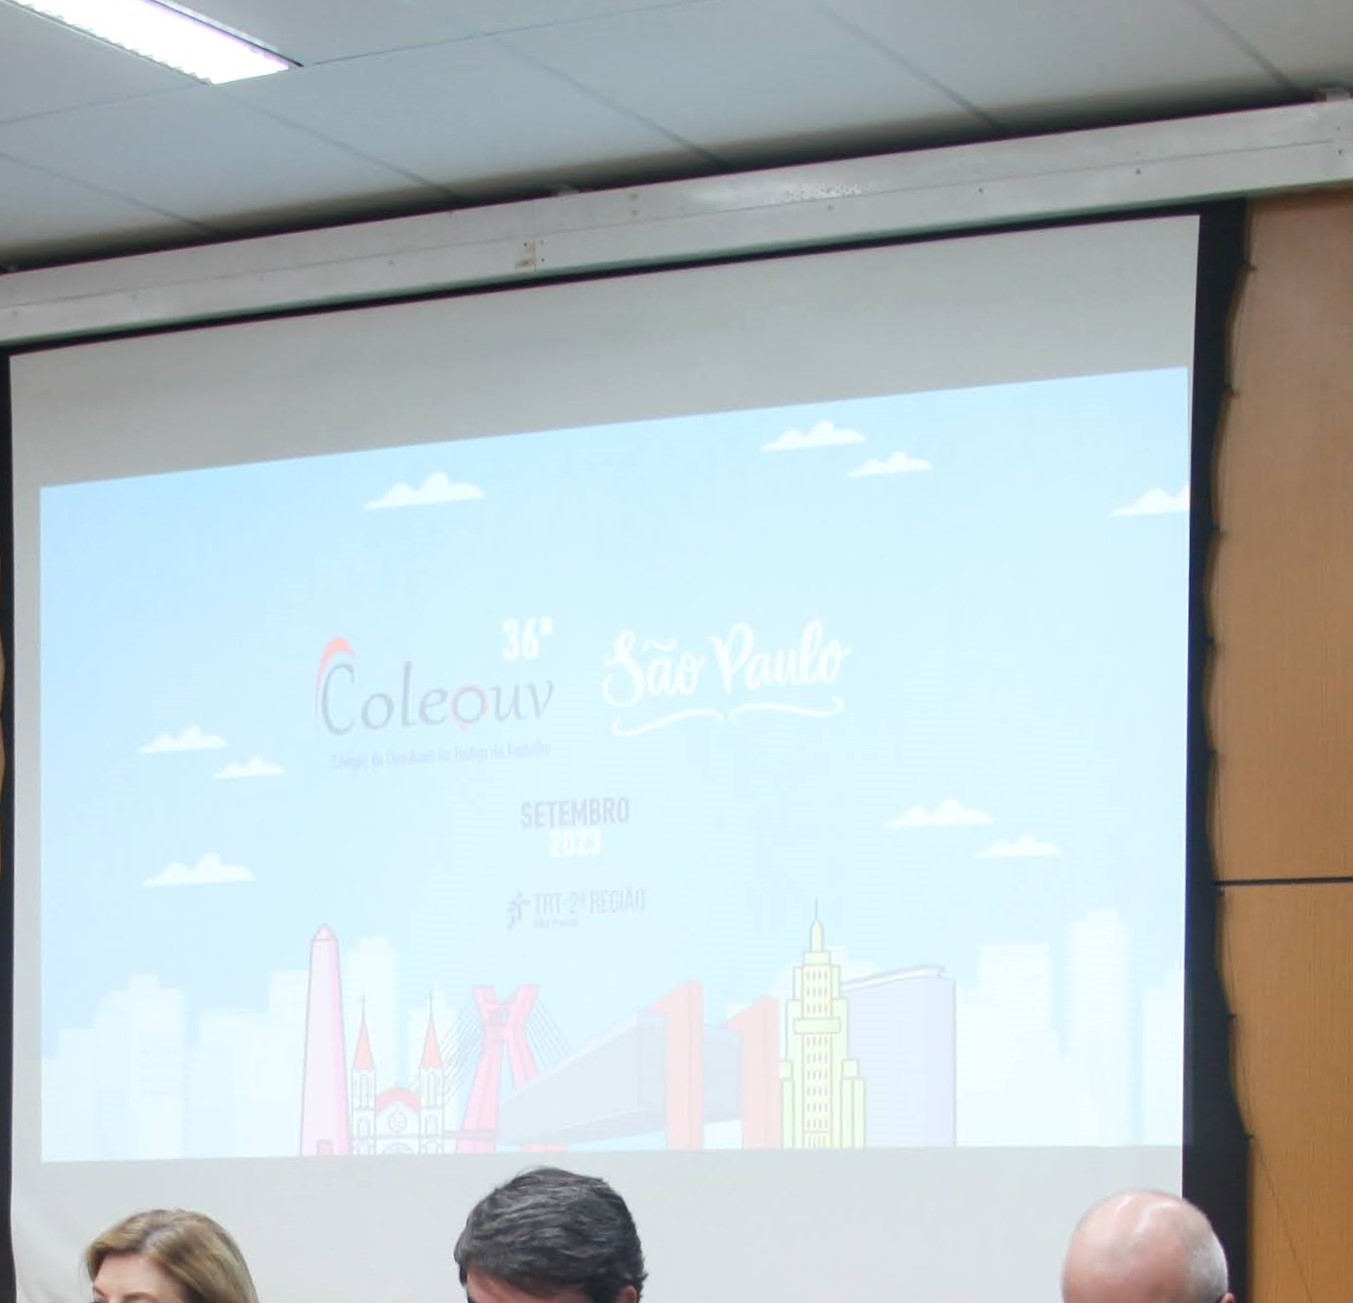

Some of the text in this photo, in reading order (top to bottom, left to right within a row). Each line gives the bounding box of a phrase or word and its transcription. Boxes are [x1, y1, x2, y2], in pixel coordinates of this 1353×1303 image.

[601, 620, 850, 707] São Paulo
[321, 658, 554, 736] Coleouv
[520, 797, 629, 829] SETEMBRO
[549, 828, 601, 857] 2023
